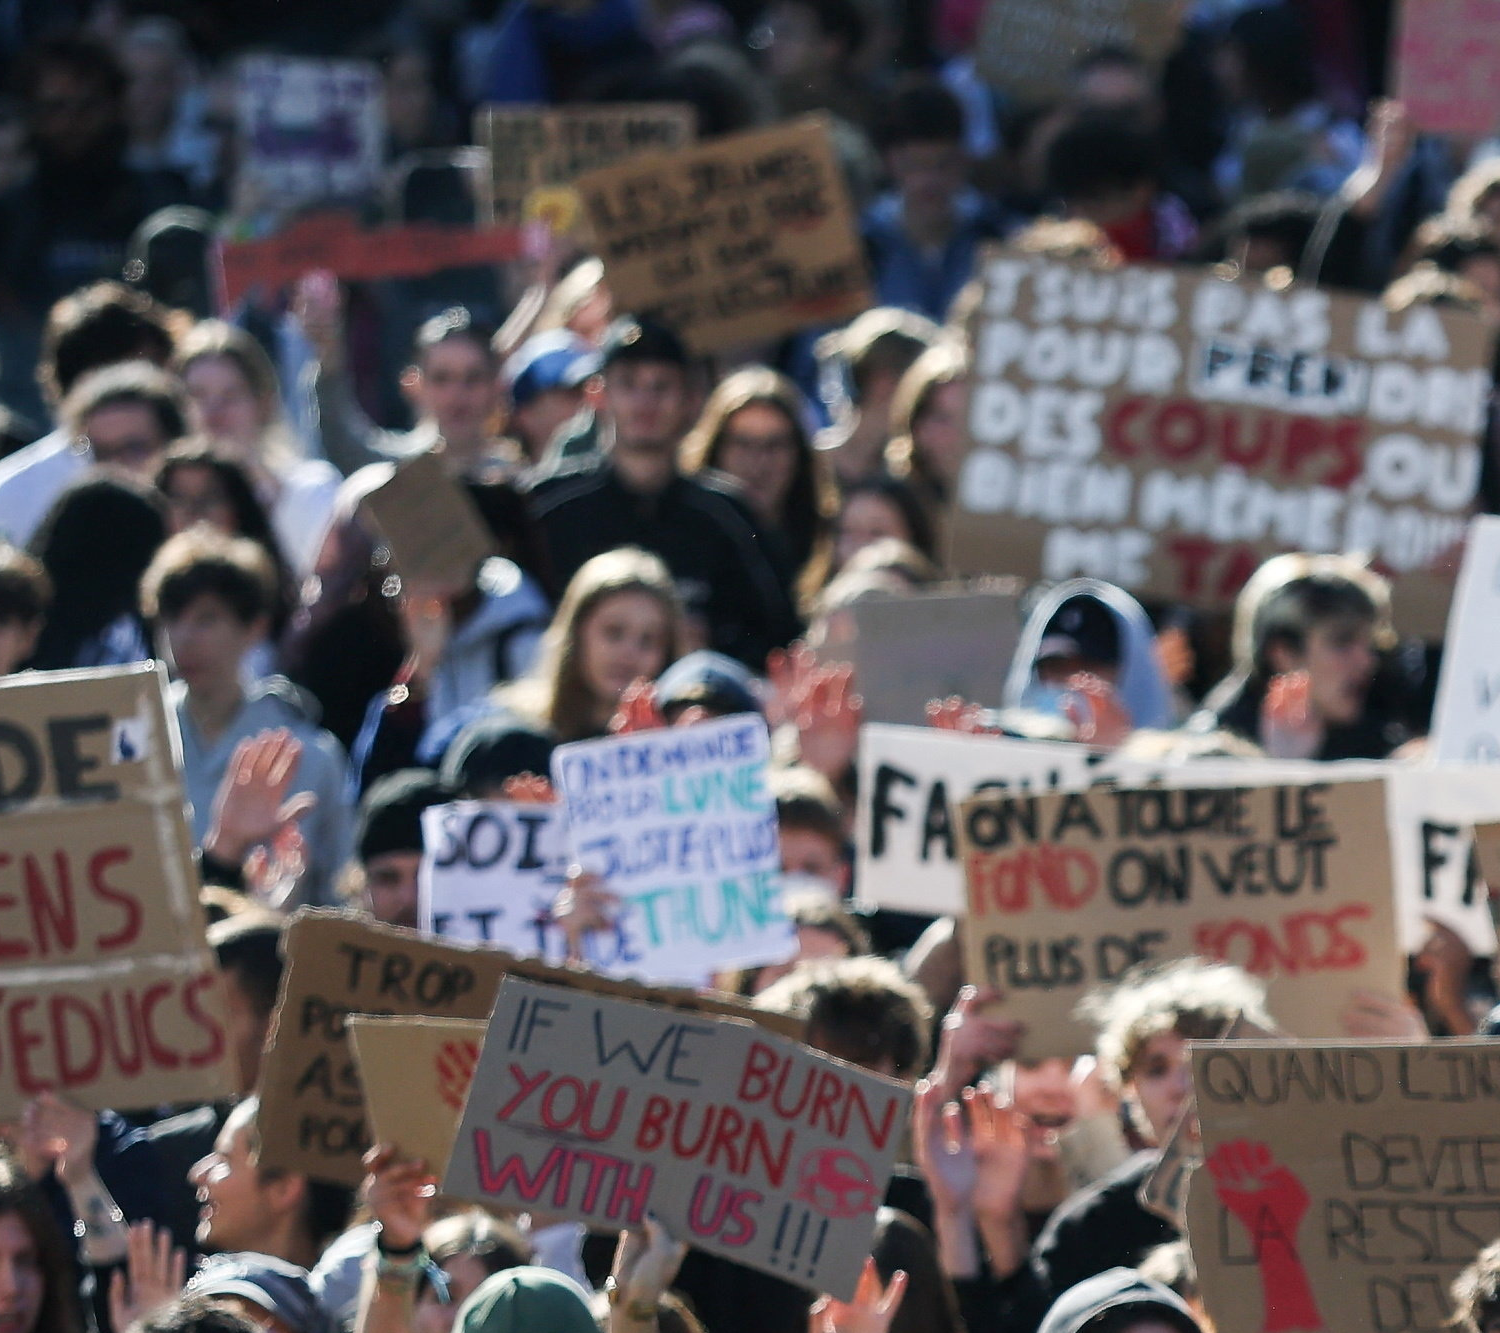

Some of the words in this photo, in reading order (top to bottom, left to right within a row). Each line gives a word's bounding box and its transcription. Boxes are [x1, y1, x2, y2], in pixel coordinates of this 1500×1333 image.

[978, 318, 1182, 394] POUR
[1191, 281, 1331, 350] PAS
[1356, 302, 1449, 359] LA
[970, 382, 1107, 461] DES
[1104, 397, 1365, 489] COUPS
[1366, 432, 1483, 510] OU
[1042, 527, 1153, 588] ME
[1106, 844, 1189, 908] ON
[1202, 836, 1339, 896] VEUT
[338, 941, 477, 1004] TROP
[507, 995, 569, 1054] IF
[594, 1008, 717, 1087] WE
[737, 1040, 899, 1152] BURN
[1201, 1047, 1385, 1102] QUAND
[497, 1062, 628, 1144] YOU
[635, 1093, 797, 1189] BURN
[472, 1128, 656, 1225] WITH
[686, 1173, 763, 1249] US
